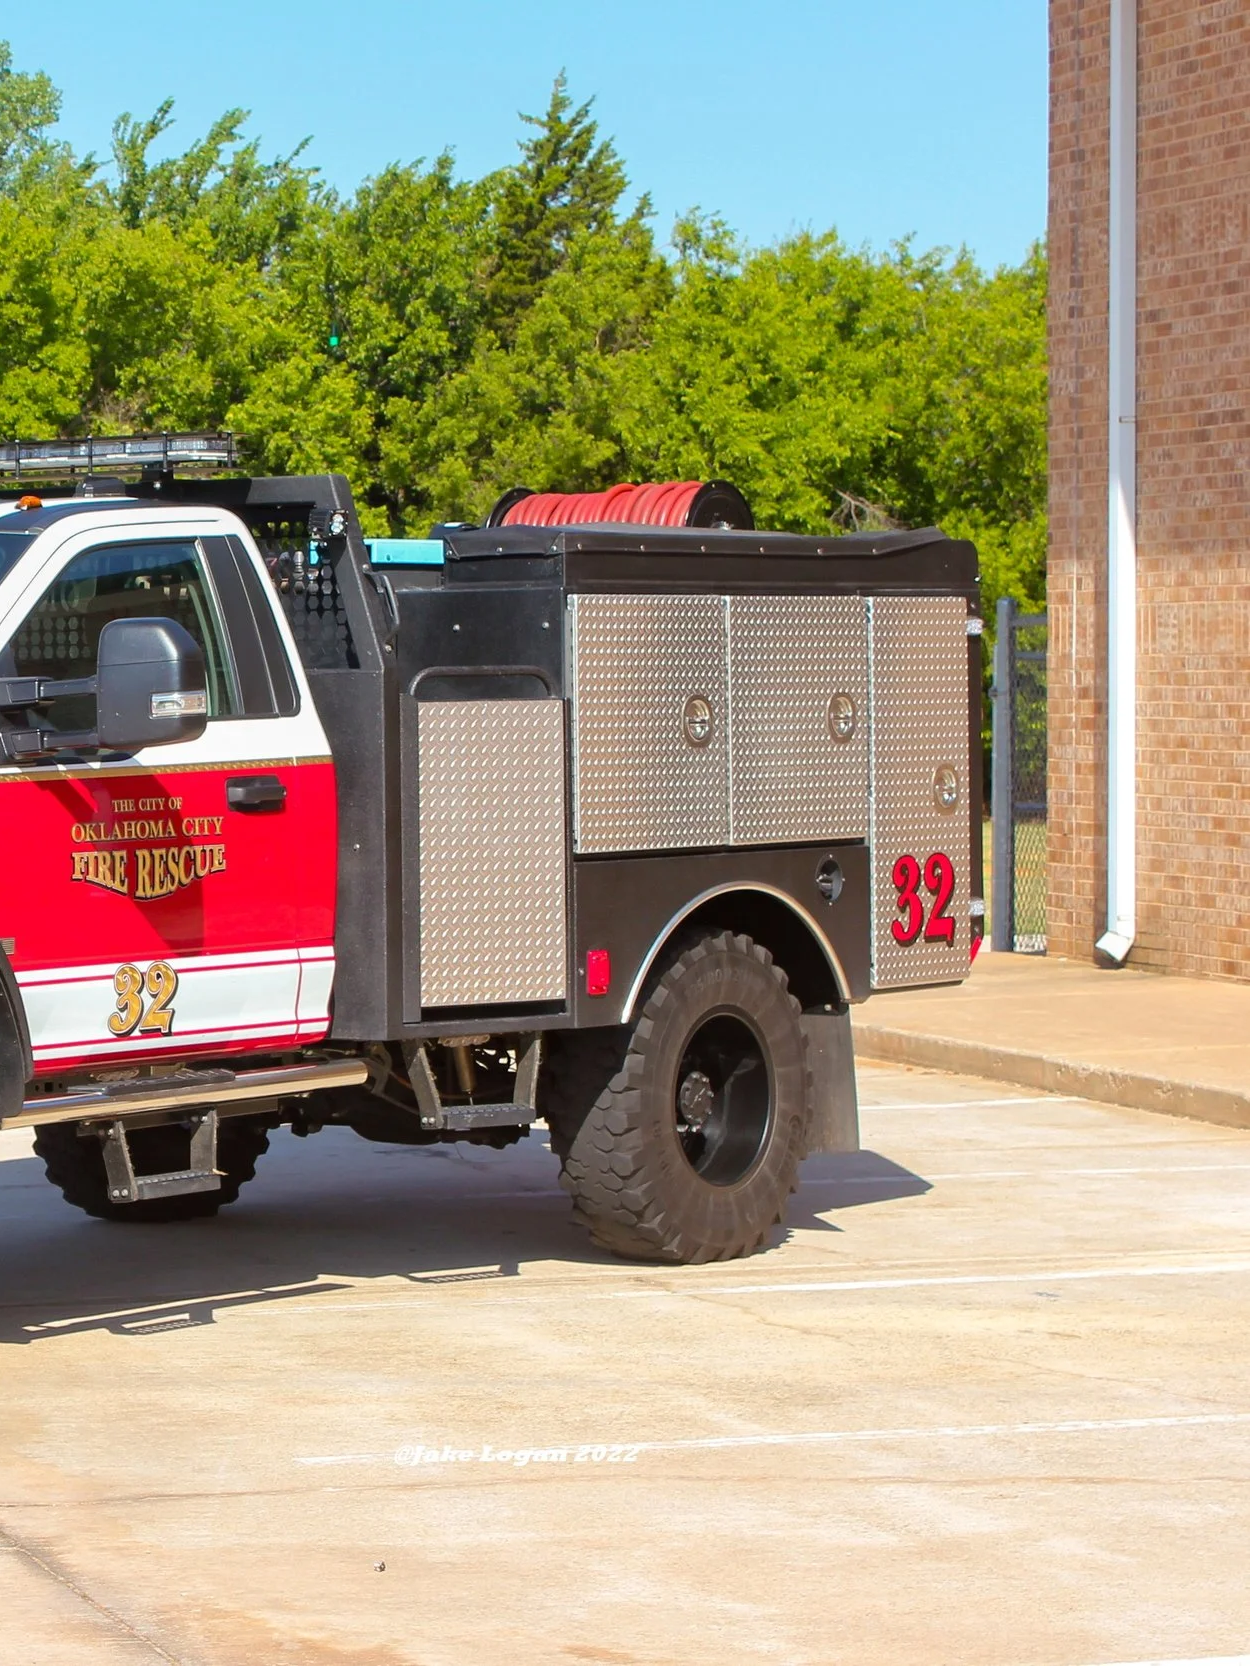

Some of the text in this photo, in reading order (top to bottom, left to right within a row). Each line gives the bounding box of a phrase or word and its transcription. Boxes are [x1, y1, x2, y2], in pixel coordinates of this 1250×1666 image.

[71, 816, 224, 843] OKLAHOMA CITY
[111, 796, 183, 813] THE CITY OF
[71, 844, 227, 902] FIRE RESCUE
[891, 852, 956, 948] 32
[107, 960, 179, 1038] 32
